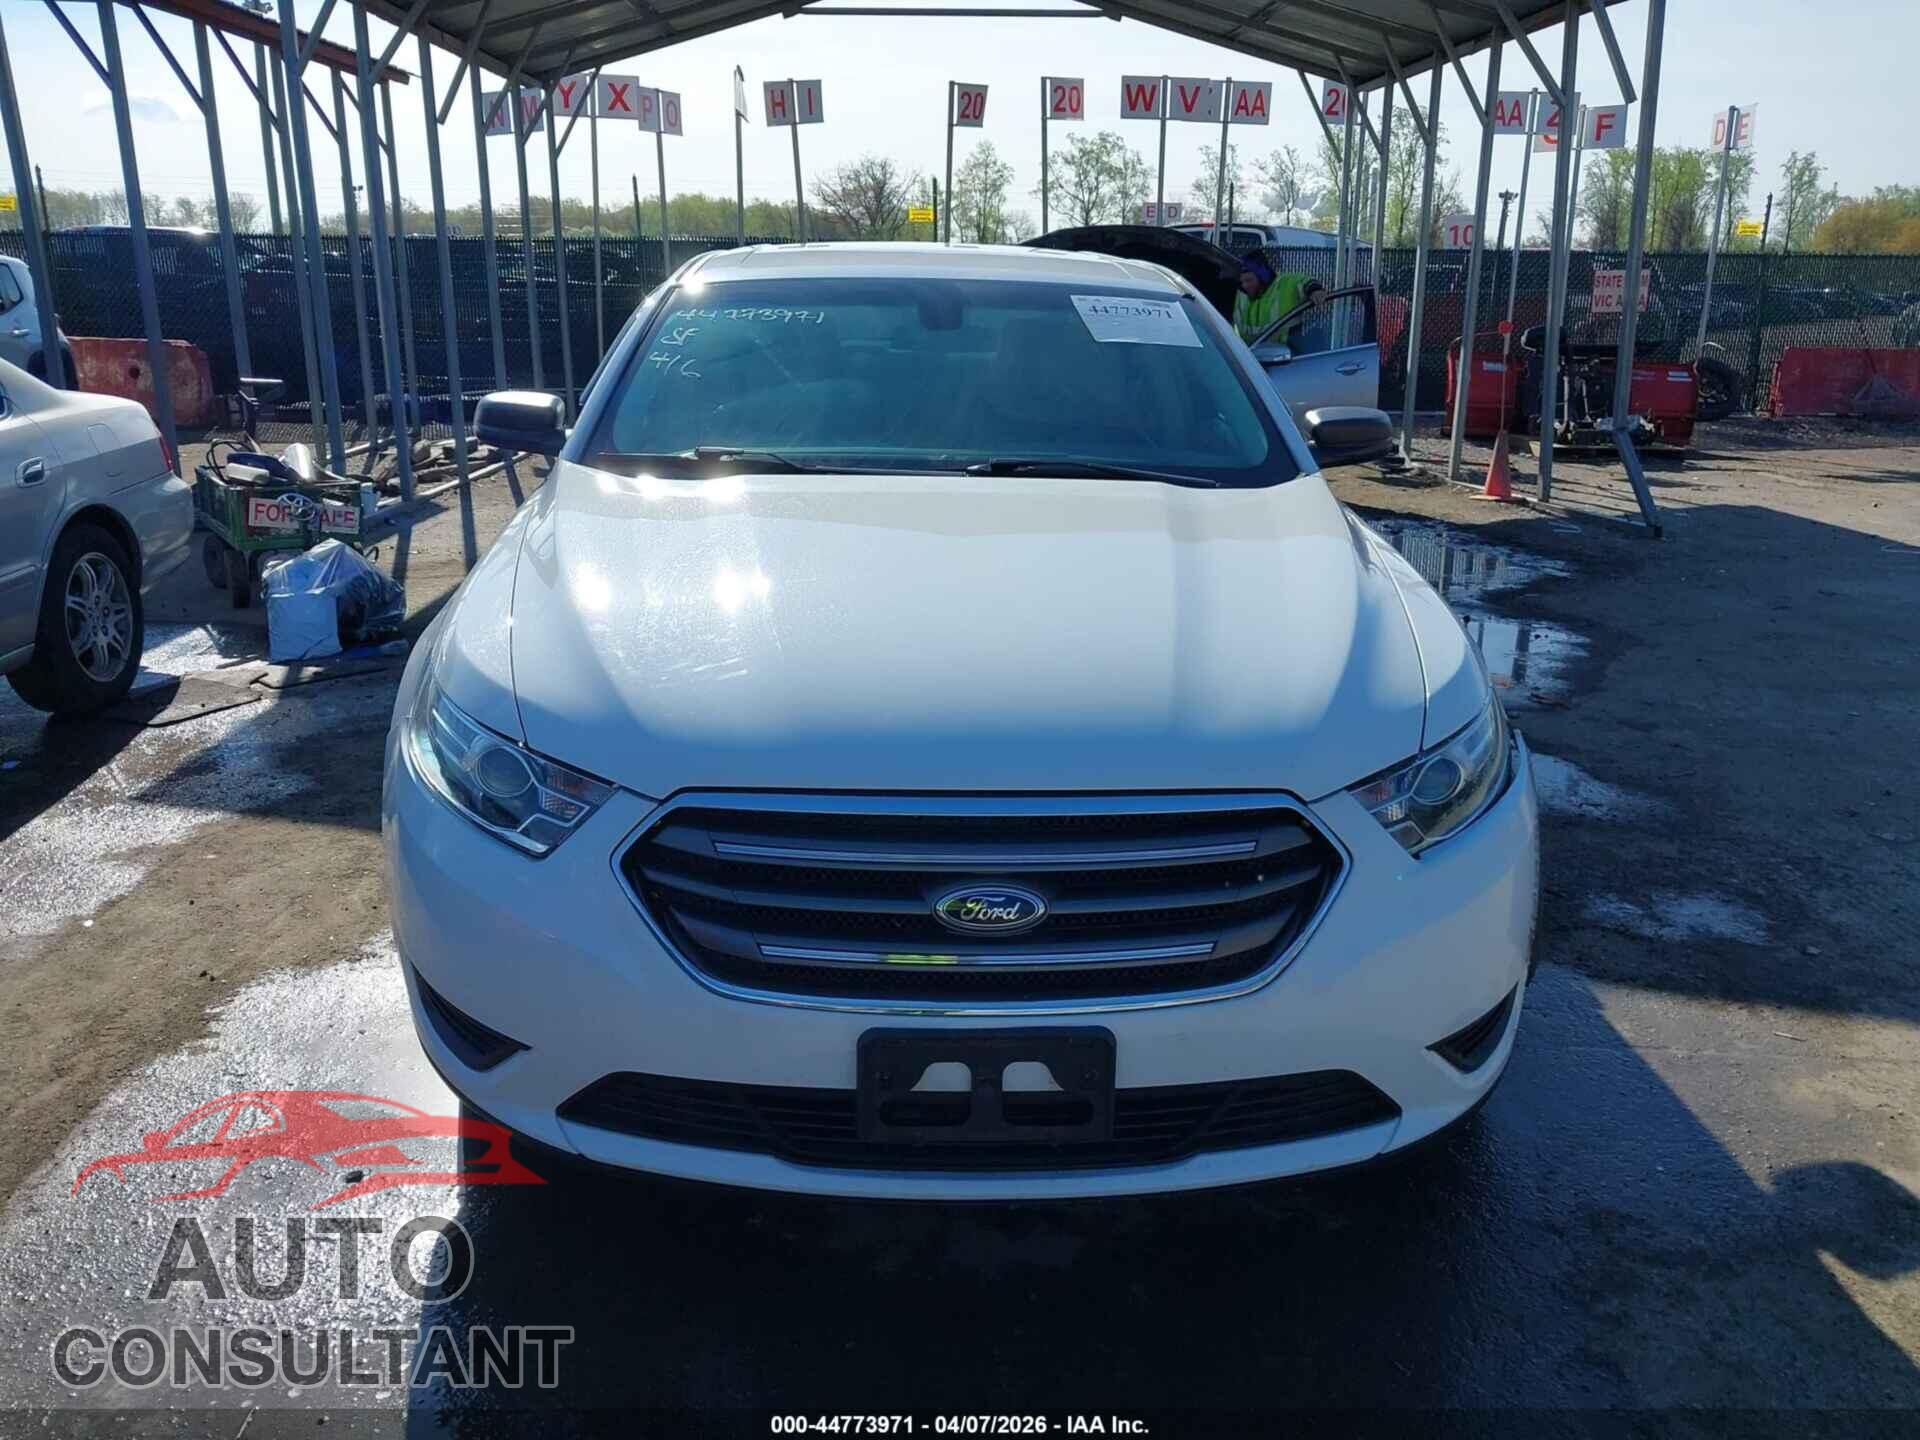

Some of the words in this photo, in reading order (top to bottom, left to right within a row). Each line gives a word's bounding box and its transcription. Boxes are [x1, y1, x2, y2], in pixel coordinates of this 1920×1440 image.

[557, 80, 576, 110] Y
[607, 82, 632, 112] X
[642, 95, 653, 123] P
[770, 88, 787, 119] H
[960, 91, 984, 120] 20
[1053, 85, 1082, 113] 20
[1125, 84, 1157, 113] W
[1177, 85, 1201, 113] V
[1234, 88, 1266, 117] AA
[1494, 99, 1523, 127] AA
[1737, 111, 1751, 141] E
[1594, 113, 1616, 142] F
[1713, 119, 1726, 146] D
[1146, 206, 1157, 218] E
[1167, 206, 1178, 218] D
[1593, 274, 1624, 288] STATE
[1087, 304, 1173, 319] 44773971
[960, 895, 1021, 921] Ford
